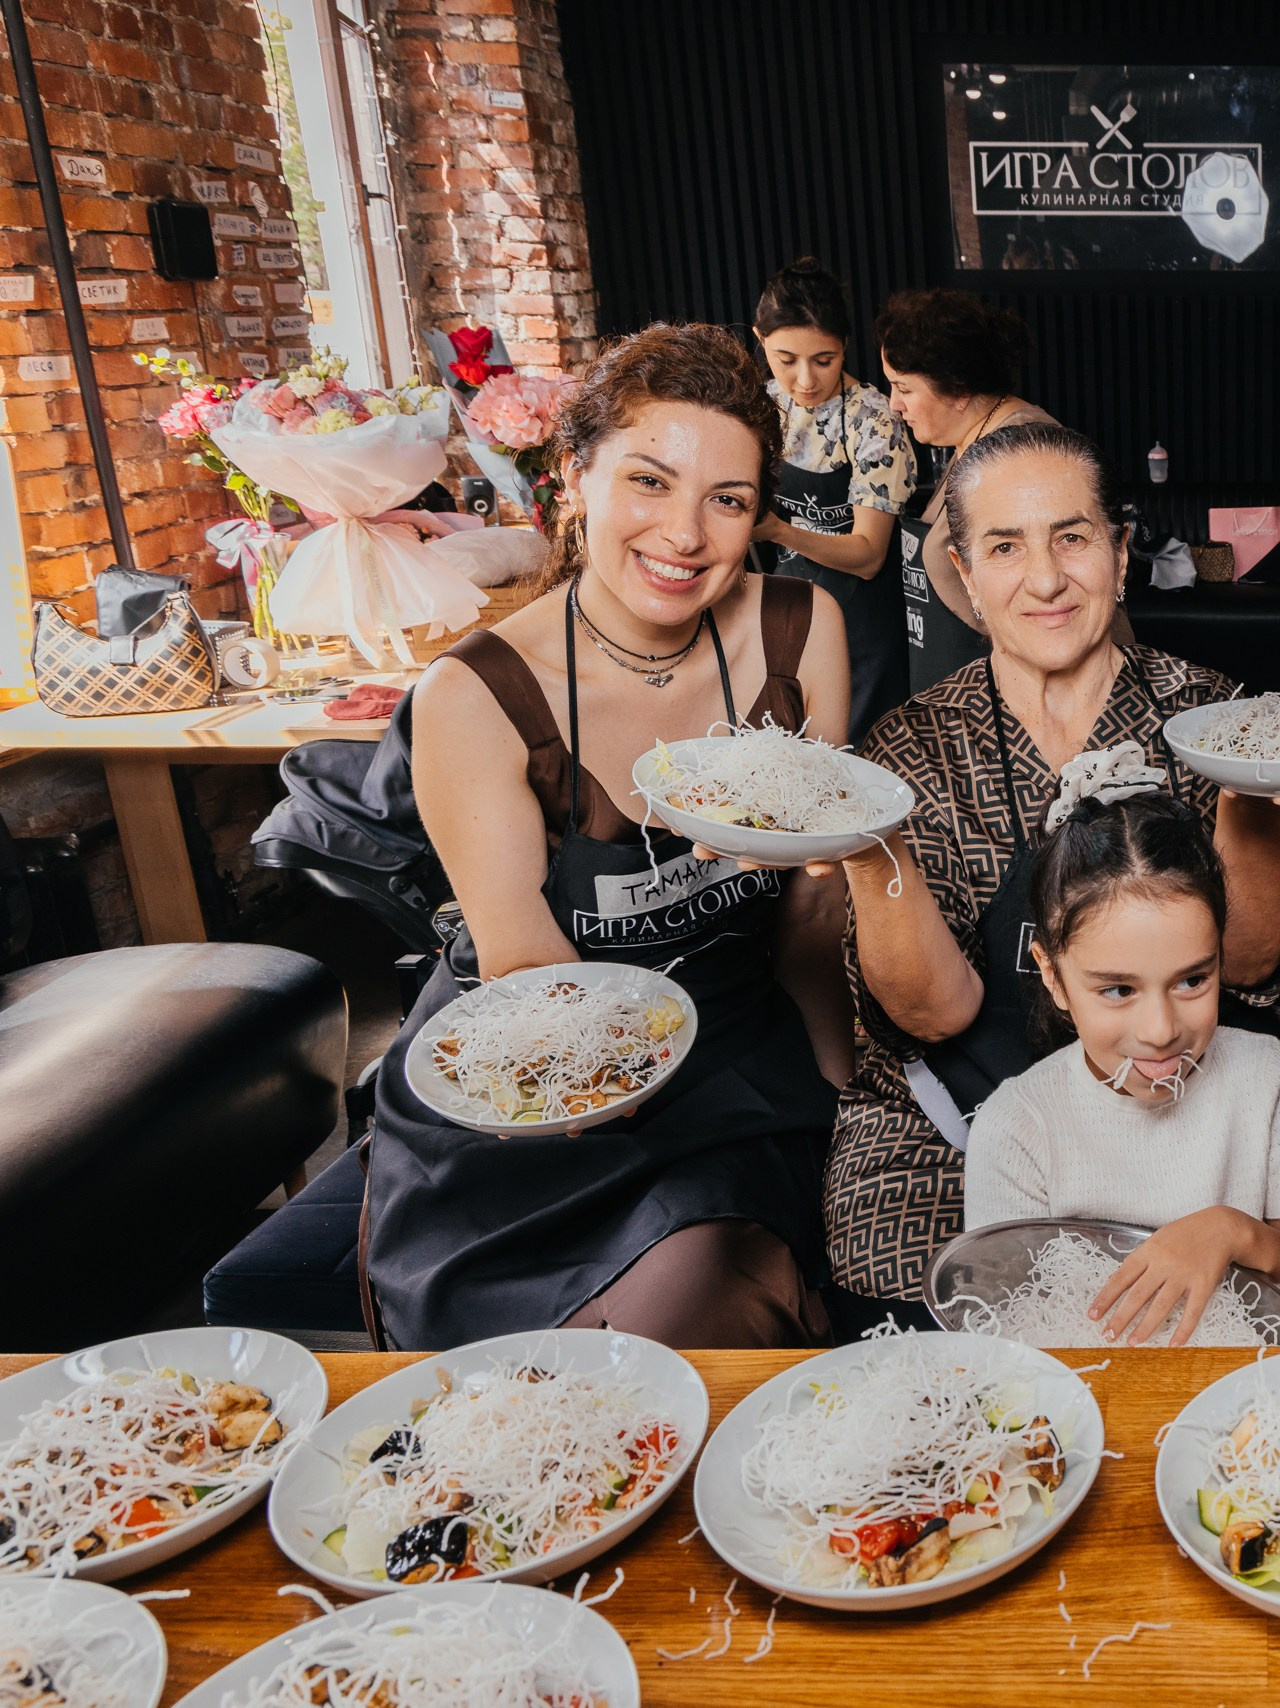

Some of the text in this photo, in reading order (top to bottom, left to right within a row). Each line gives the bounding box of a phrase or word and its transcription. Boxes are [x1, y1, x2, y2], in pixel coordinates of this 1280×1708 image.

[980, 151, 1250, 190] ИГРА СТОЛОВ
[1020, 194, 1131, 206] КУЛИНАРНАЯ
[581, 866, 772, 940] ИГРА СТОЛОВ
[611, 923, 696, 944] КУЛИНАРНАЯ
